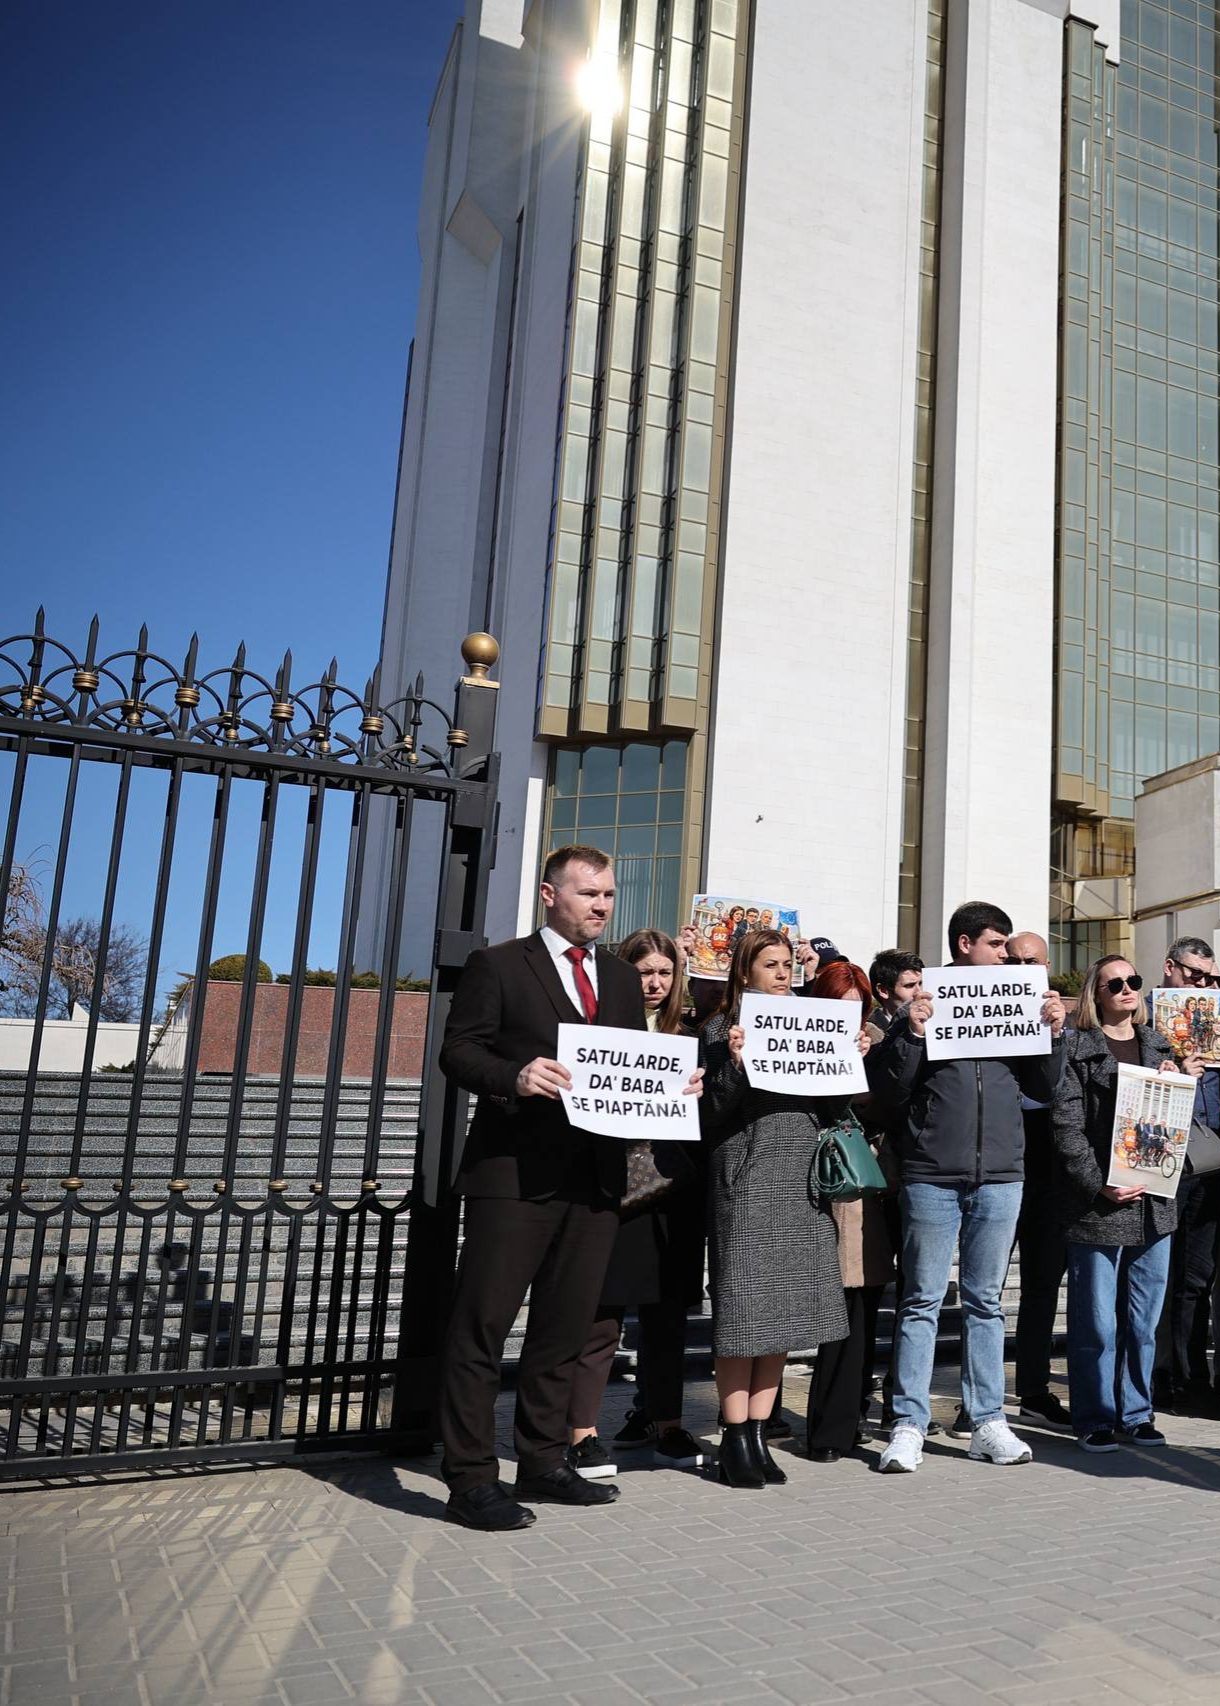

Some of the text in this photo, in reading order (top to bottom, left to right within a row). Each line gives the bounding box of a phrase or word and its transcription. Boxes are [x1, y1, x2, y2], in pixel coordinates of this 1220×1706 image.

[713, 933, 727, 941] GAZ
[937, 983, 1036, 999] SATUL ARDE,
[953, 1003, 1024, 1019] DA' BABA
[754, 1014, 848, 1035] SATUL ARDE,
[935, 1020, 1041, 1040] SE PIAPTĂNĂ!
[767, 1038, 835, 1054] DA' BABA
[576, 1047, 684, 1075] SATUL ARDE,
[752, 1059, 854, 1076] SE PIAPTĂNĂ!
[589, 1074, 665, 1095] DA' BABA
[571, 1096, 687, 1118] SE PIAPTĂNĂ!
